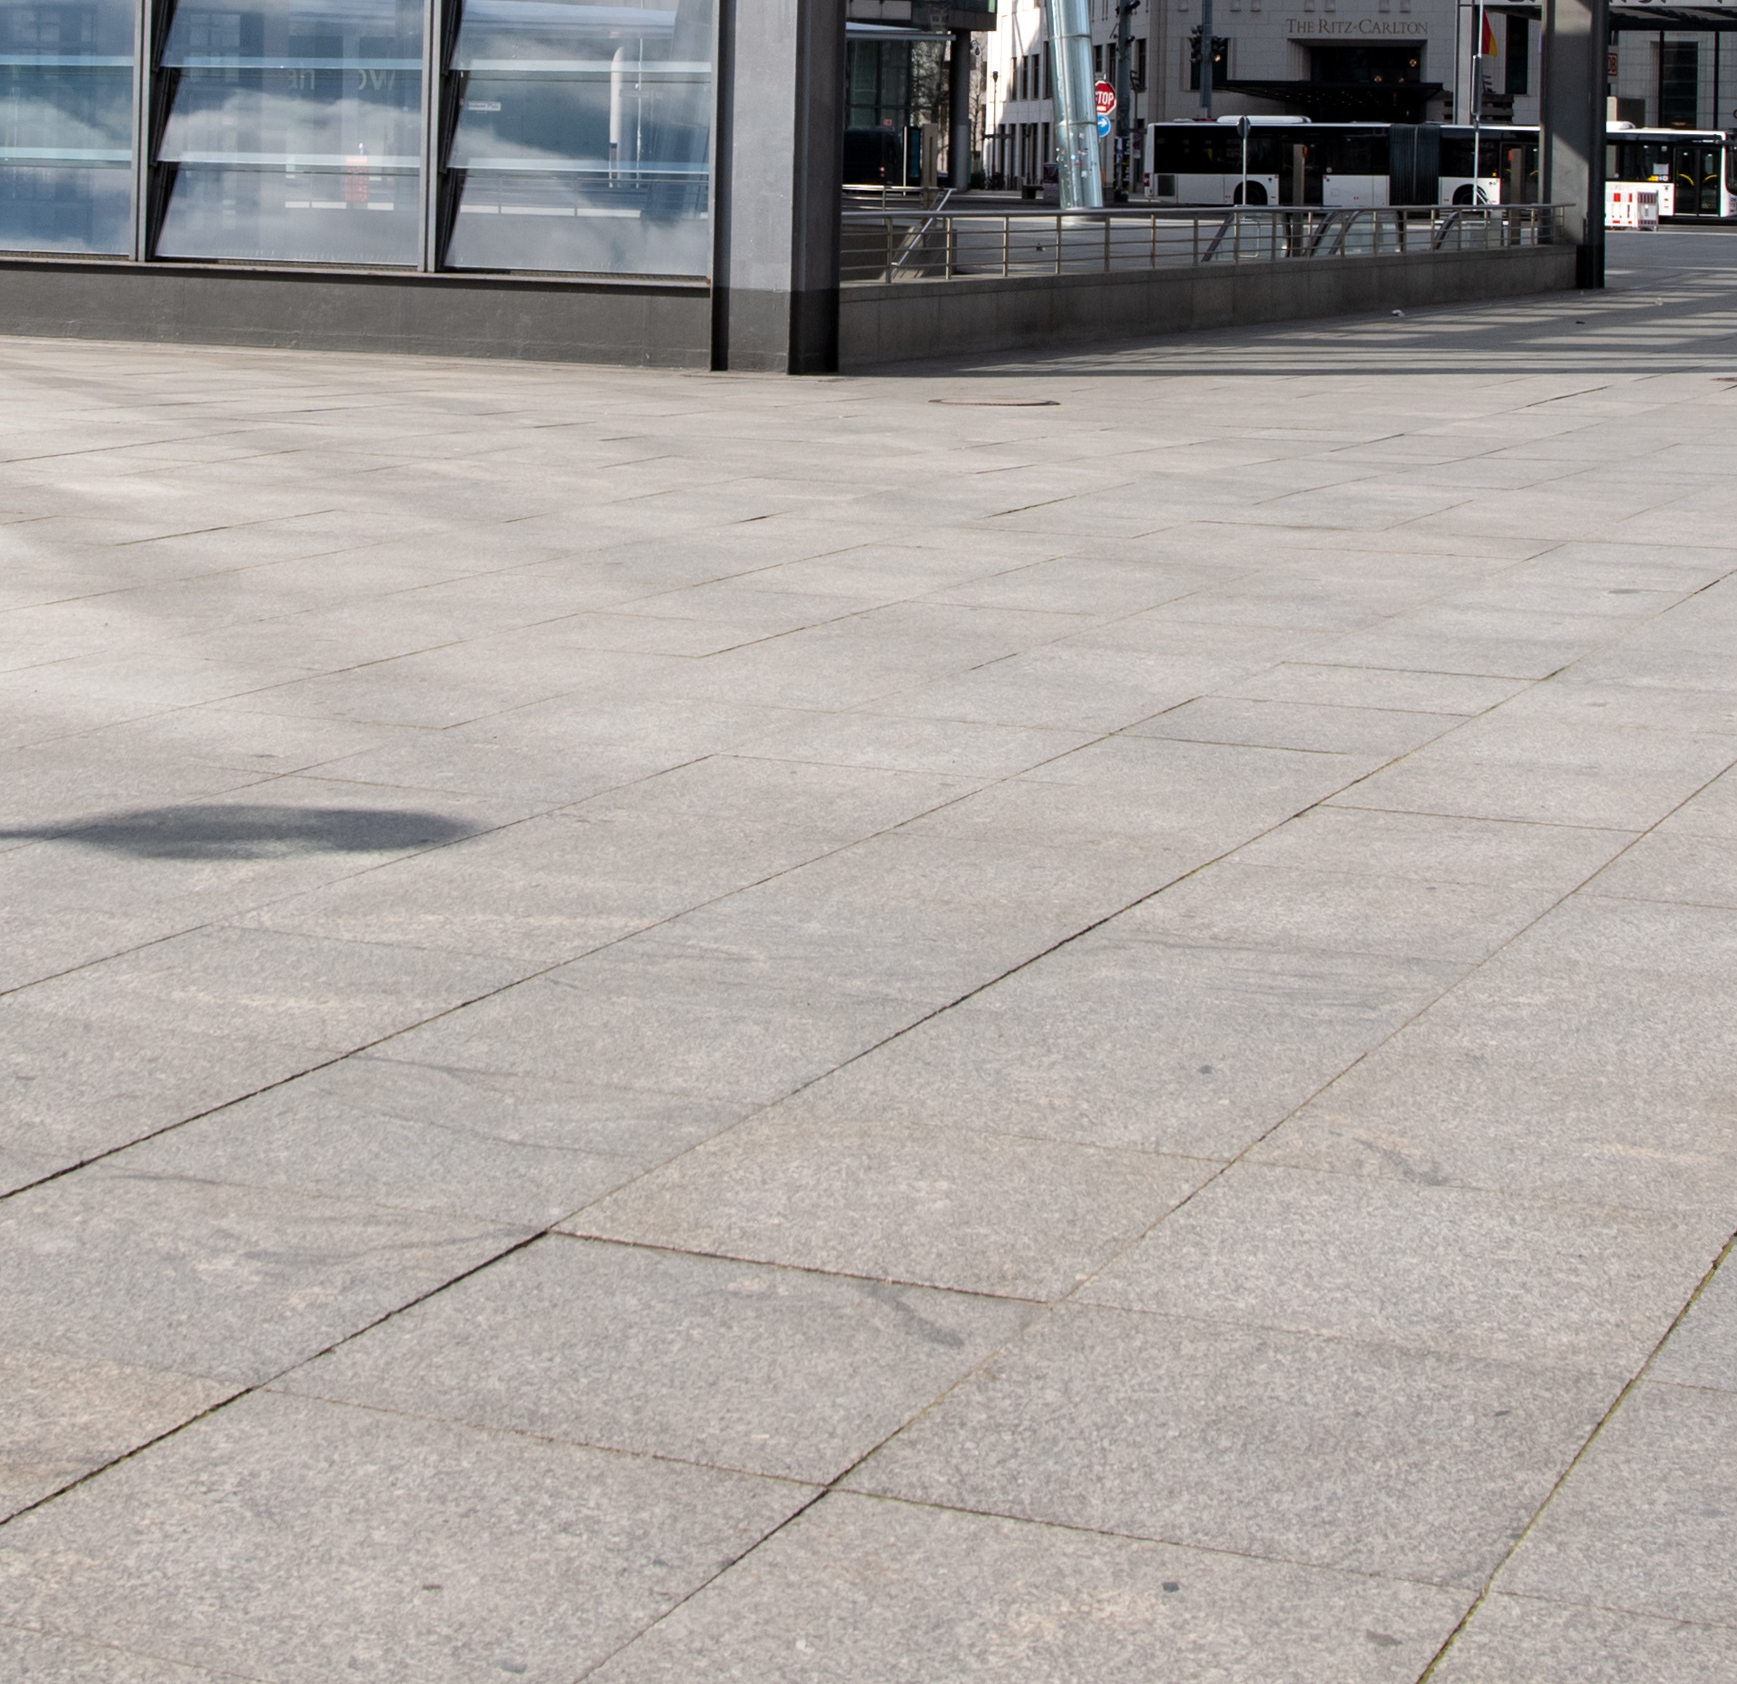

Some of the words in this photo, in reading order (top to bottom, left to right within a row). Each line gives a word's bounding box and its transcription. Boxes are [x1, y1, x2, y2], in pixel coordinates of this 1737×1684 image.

[1286, 18, 1314, 34] THE
[1318, 18, 1428, 35] RITZ-CARLTON
[1095, 91, 1114, 105] TOP
